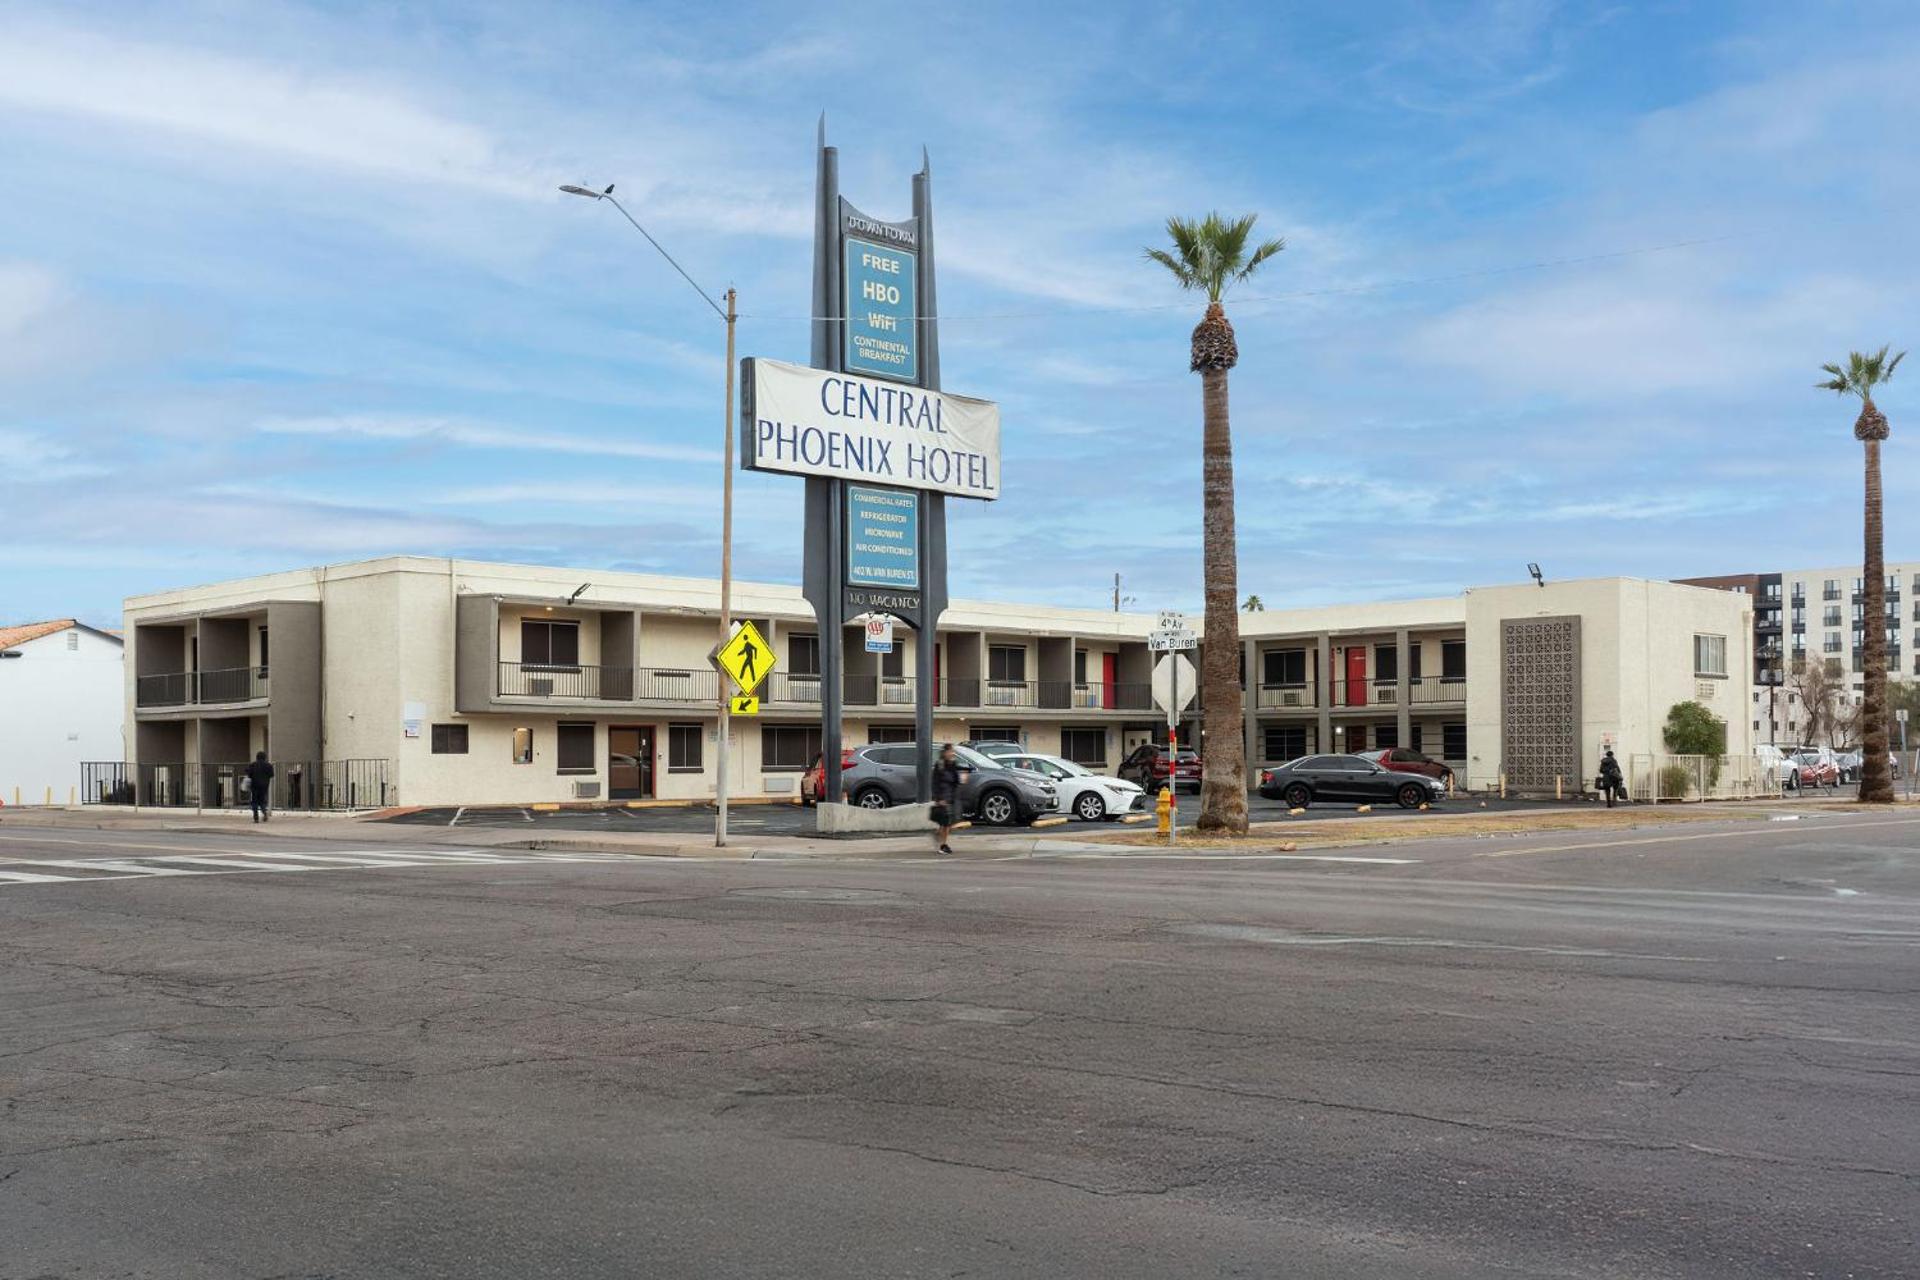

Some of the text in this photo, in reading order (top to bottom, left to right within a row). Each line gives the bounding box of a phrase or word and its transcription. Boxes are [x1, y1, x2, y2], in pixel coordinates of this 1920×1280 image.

[848, 216, 915, 244] DOWNTOWN
[862, 253, 900, 274] FREE
[863, 280, 900, 305] HBO
[853, 335, 910, 355] CONTINENTAL
[859, 347, 906, 365] BREAKFAST
[821, 377, 948, 434] CENTRAL
[757, 419, 994, 490] PHOENIX HOTEL
[854, 493, 894, 505] COMMERCIAL
[860, 511, 907, 524] REFRIGERATOR
[864, 527, 904, 540] MICROWAVE
[855, 543, 913, 557] AIR CONDITIONED
[849, 592, 920, 609] NO VACANCY
[1151, 638, 1195, 649] Van Buren
